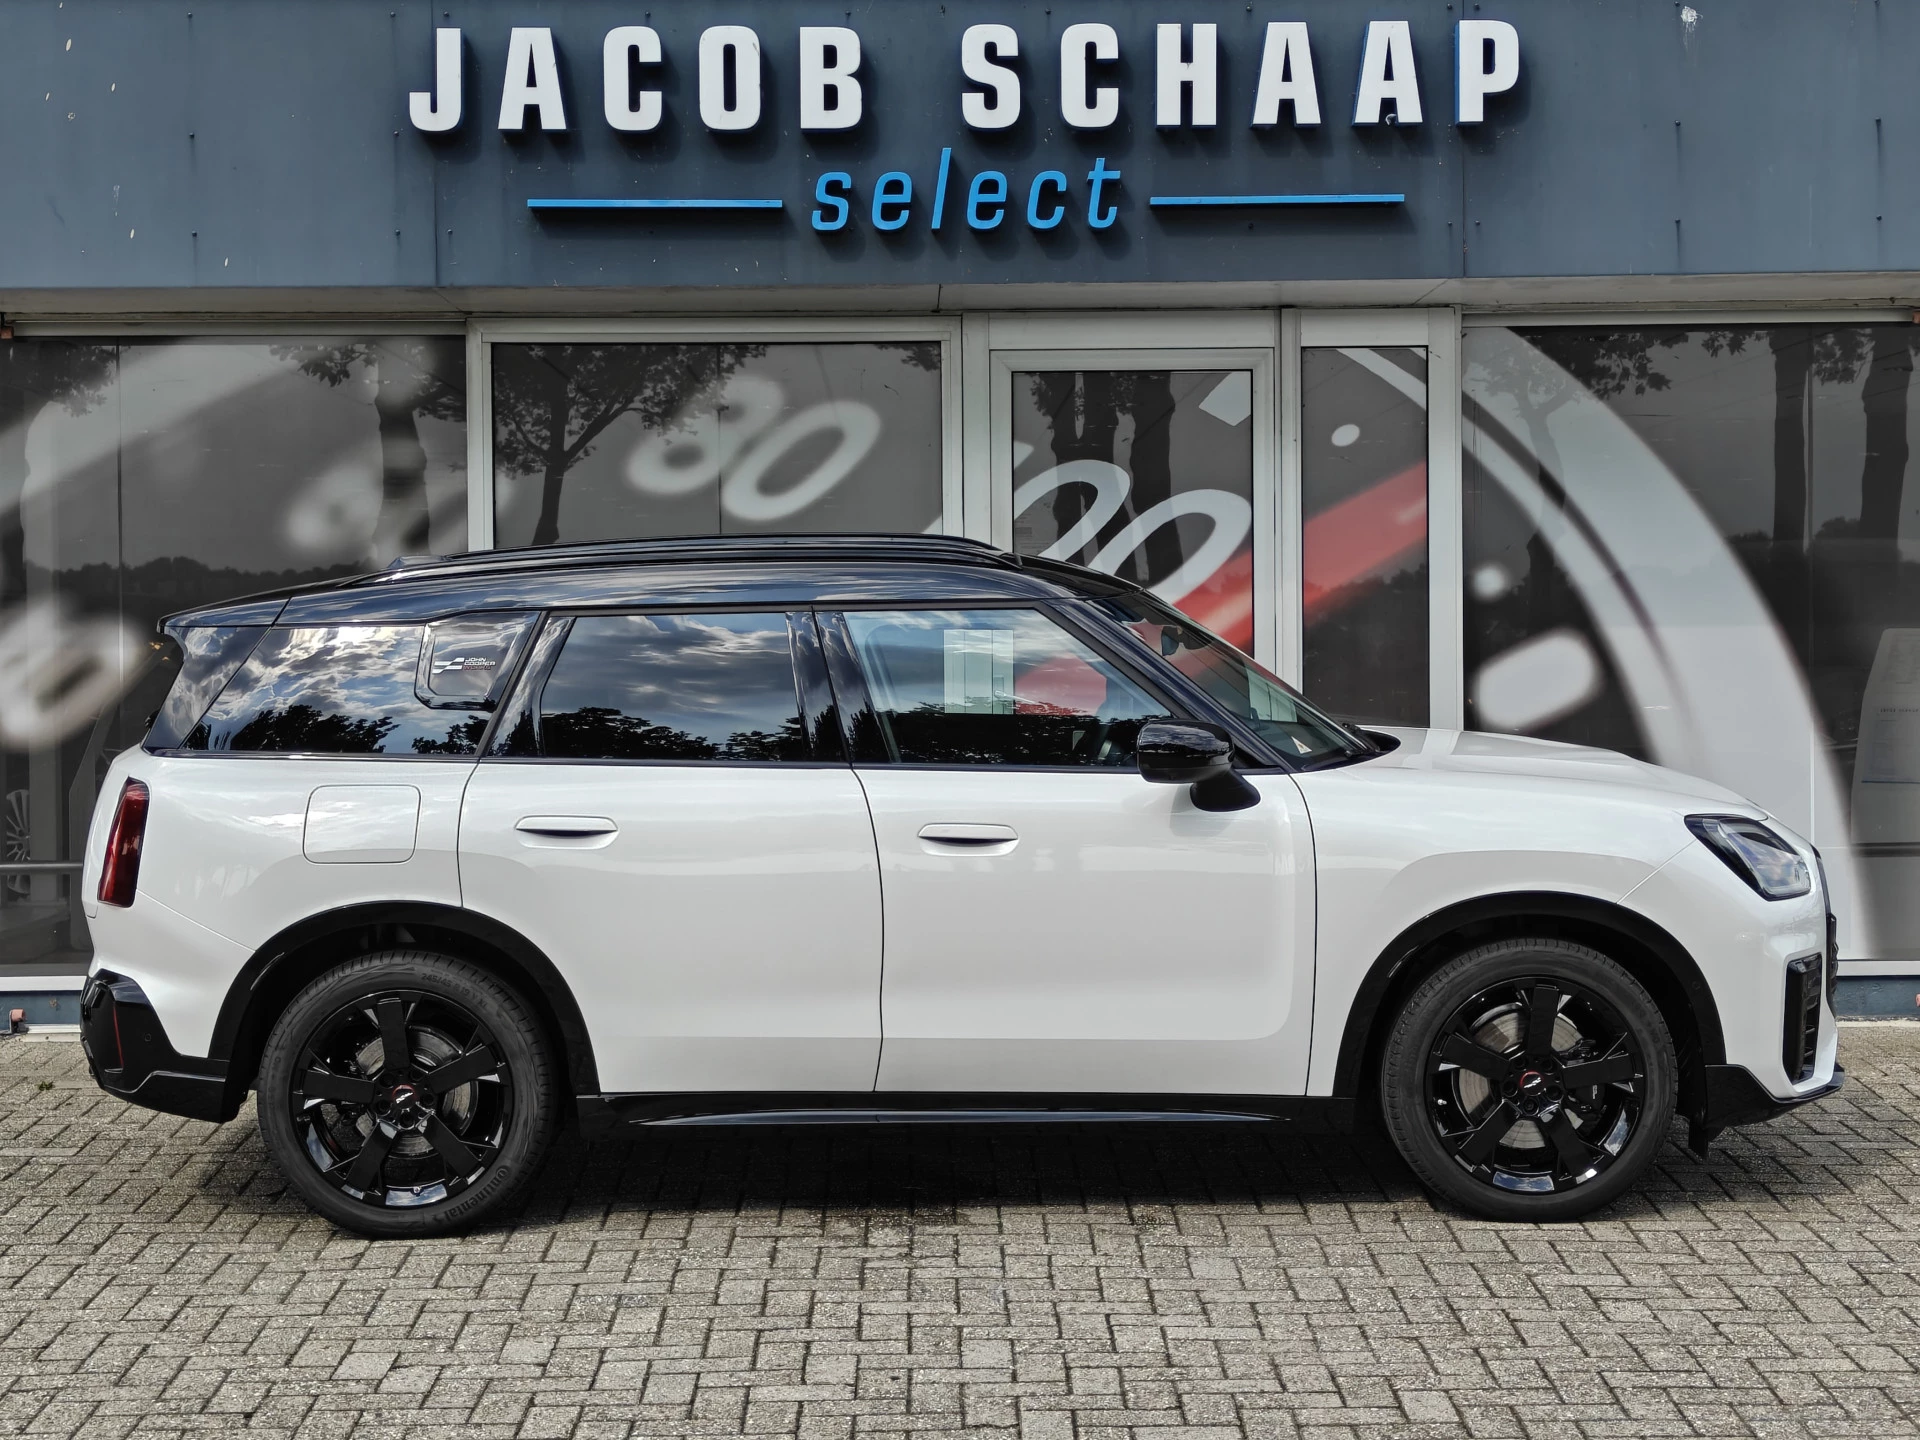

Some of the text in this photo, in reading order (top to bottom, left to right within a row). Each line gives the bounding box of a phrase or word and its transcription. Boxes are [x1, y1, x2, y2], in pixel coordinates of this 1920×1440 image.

[408, 19, 1520, 133] JACOB SCHAAP
[810, 147, 1122, 233] select
[444, 1165, 511, 1221] Continental
